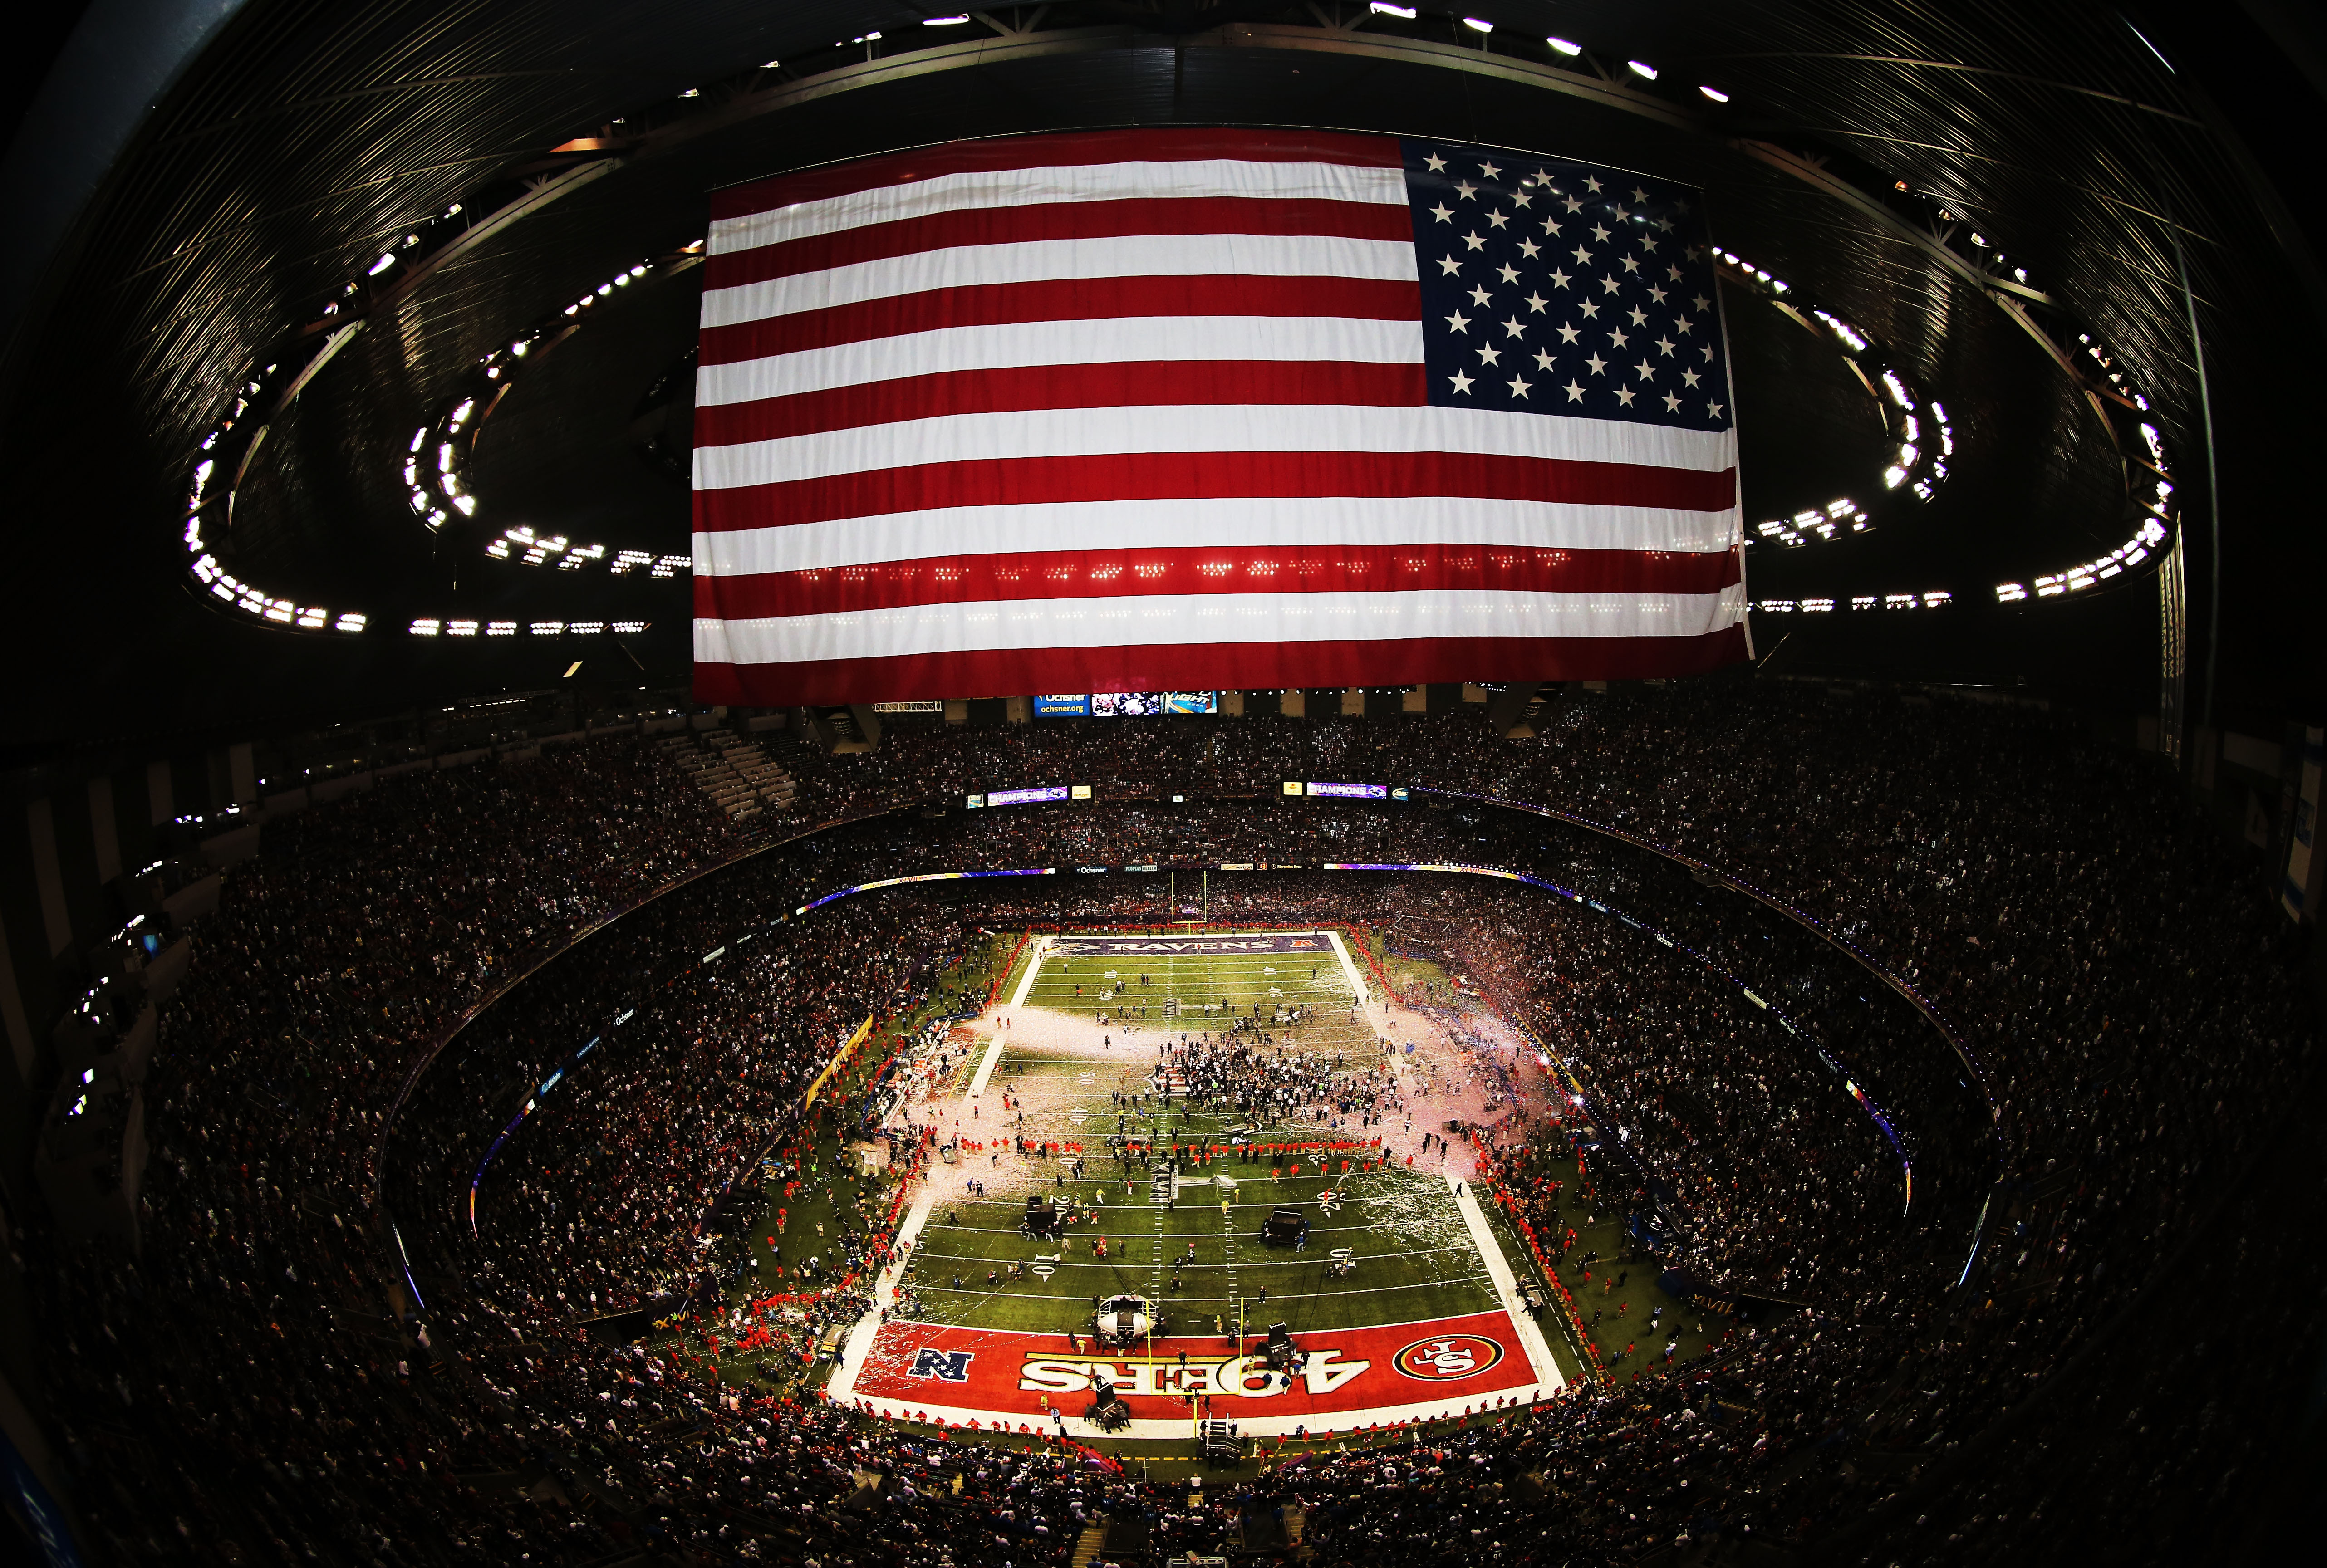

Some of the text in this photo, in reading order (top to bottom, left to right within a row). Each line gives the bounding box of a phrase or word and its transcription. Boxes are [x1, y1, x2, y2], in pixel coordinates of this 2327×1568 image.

[1169, 694, 1210, 704] LIGHT
[1308, 785, 1367, 795] CHAMPIONS
[989, 791, 1047, 803] CHAMPIONS
[1107, 942, 1275, 951] RAVENS
[1657, 933, 1673, 948] Ochsner
[933, 946, 955, 955] NOLA
[616, 1009, 634, 1026] Ochsner
[1149, 1162, 1169, 1203] XLVII
[1018, 1349, 1370, 1397] 49ERS
